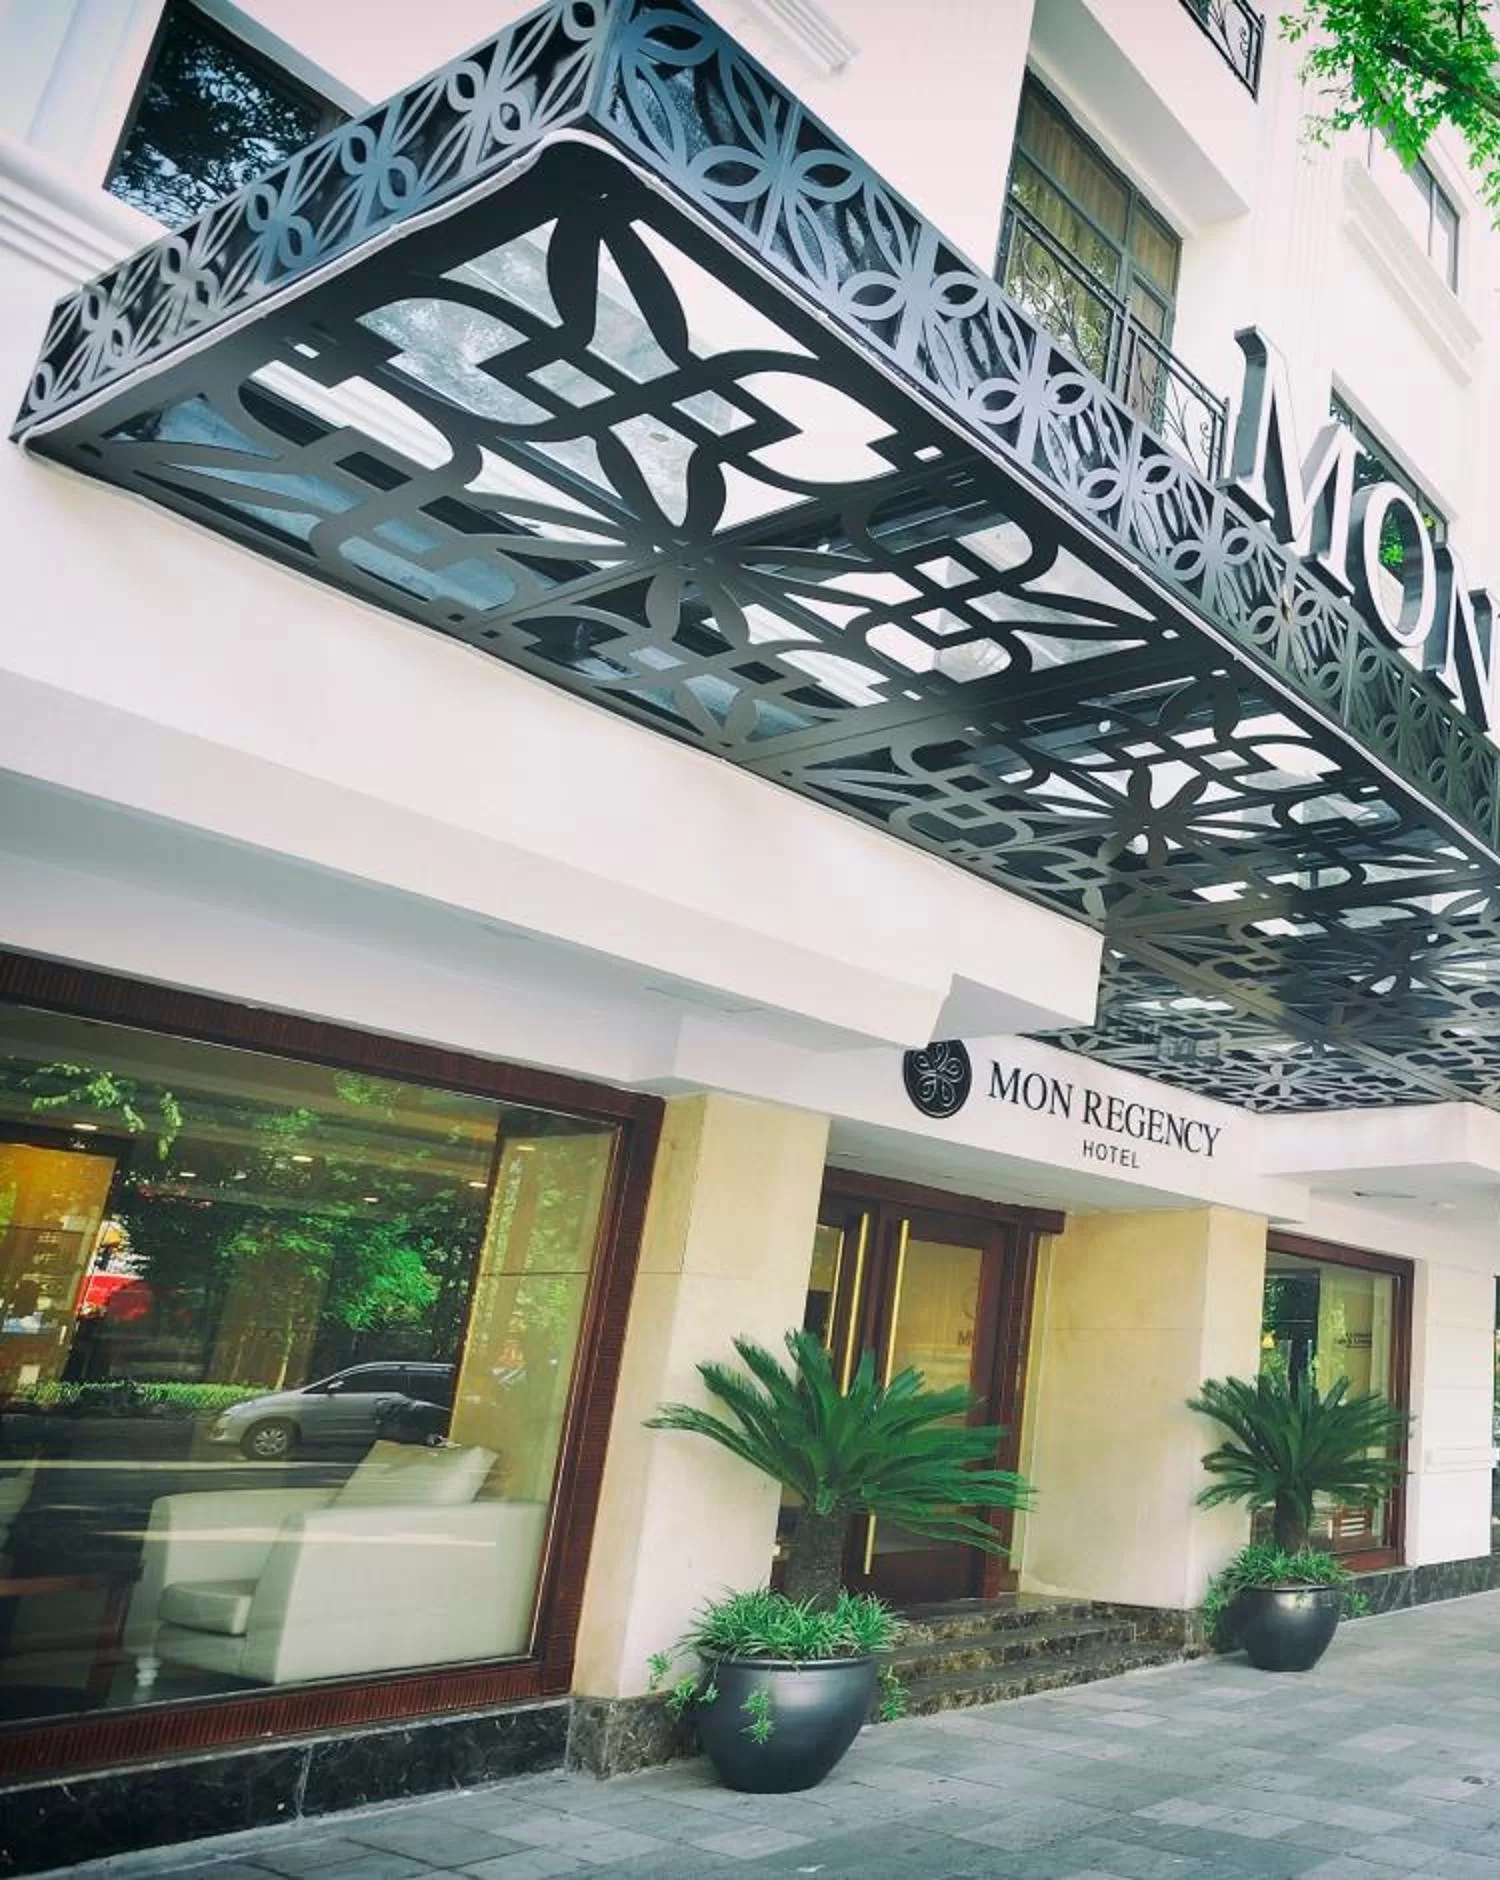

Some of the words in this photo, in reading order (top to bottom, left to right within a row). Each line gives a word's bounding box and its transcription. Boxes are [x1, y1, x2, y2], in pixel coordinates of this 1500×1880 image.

[987, 1059, 1074, 1119] MON
[1082, 1088, 1222, 1158] REGENCY
[1082, 1139, 1140, 1169] HOTEL
